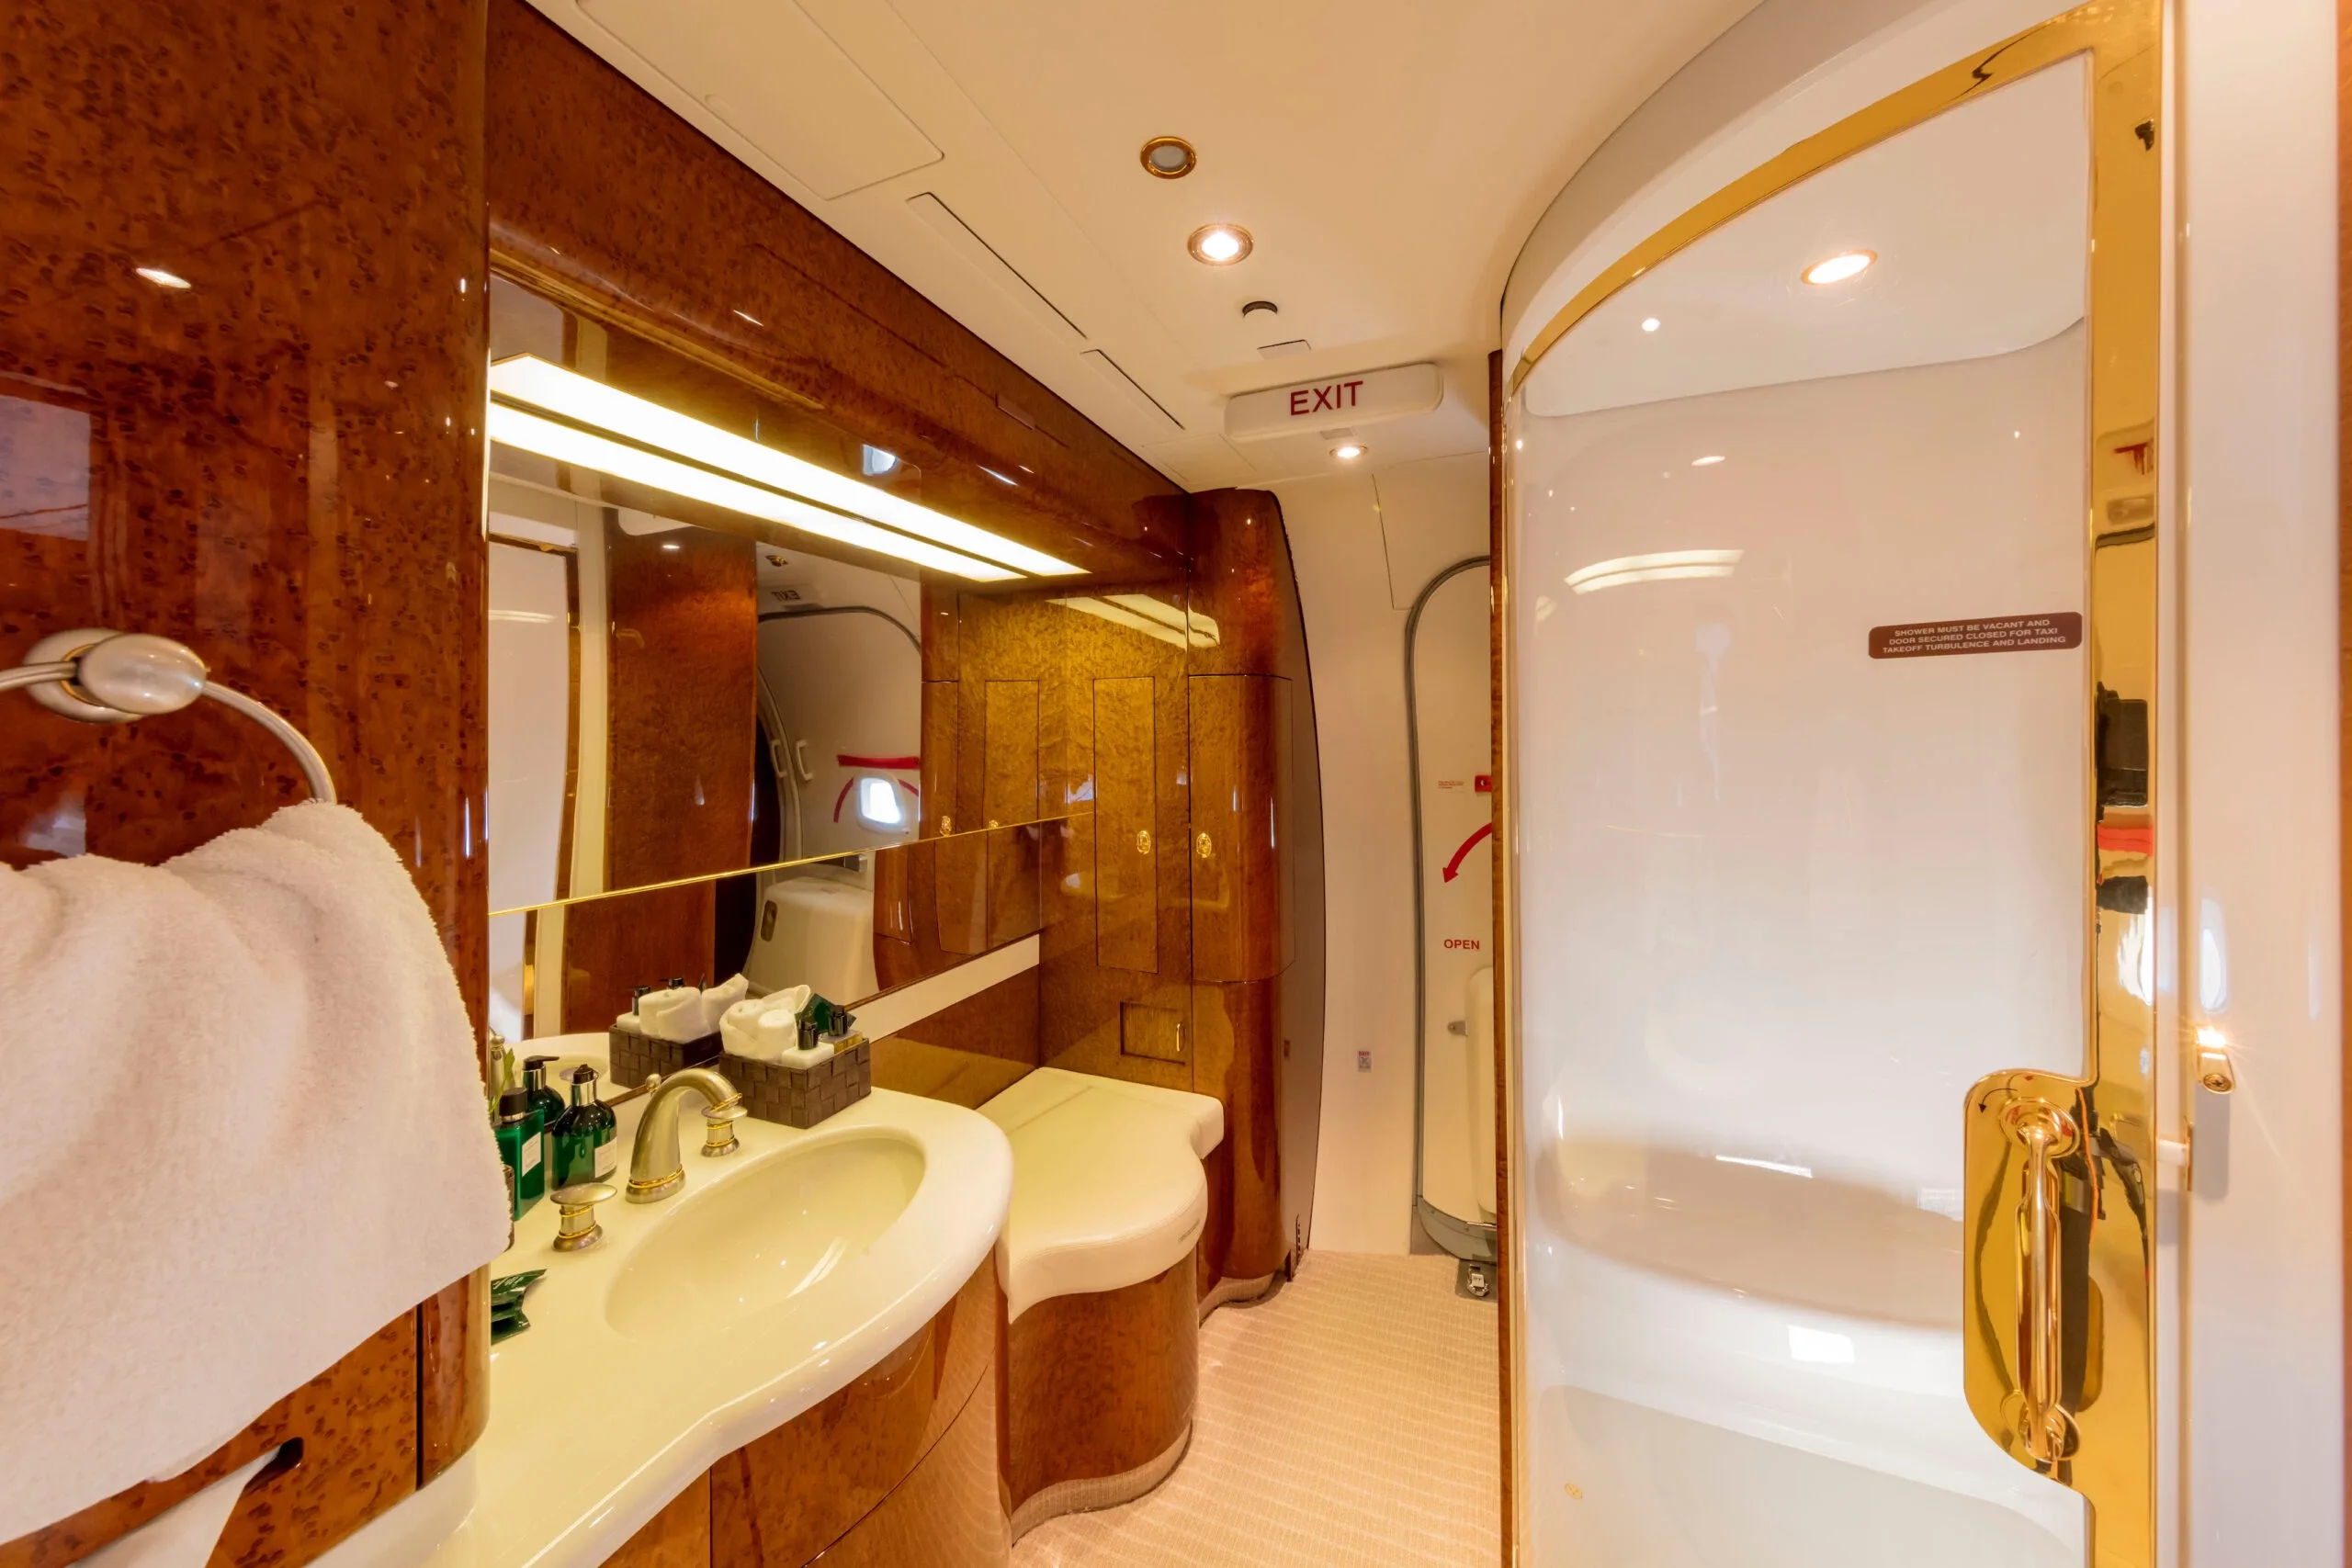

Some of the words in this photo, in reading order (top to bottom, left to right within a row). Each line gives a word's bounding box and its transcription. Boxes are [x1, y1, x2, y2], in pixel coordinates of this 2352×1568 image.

[1290, 380, 1363, 416] EXIT
[1889, 636, 1916, 645] DOOR
[1917, 633, 1963, 643] SECURED
[1965, 630, 2007, 639] CLOSED
[2009, 628, 2031, 637] FOR
[2034, 627, 2058, 636] TAXI
[1894, 627, 1935, 637] SHOWER
[1937, 625, 1964, 633] MUST
[1983, 620, 2024, 630] VACANT
[1883, 645, 1923, 653] TAKEOFF
[1925, 640, 1990, 650] TURBULENCE
[2017, 636, 2066, 646] LANDING
[1443, 939, 1480, 950] OPEN
